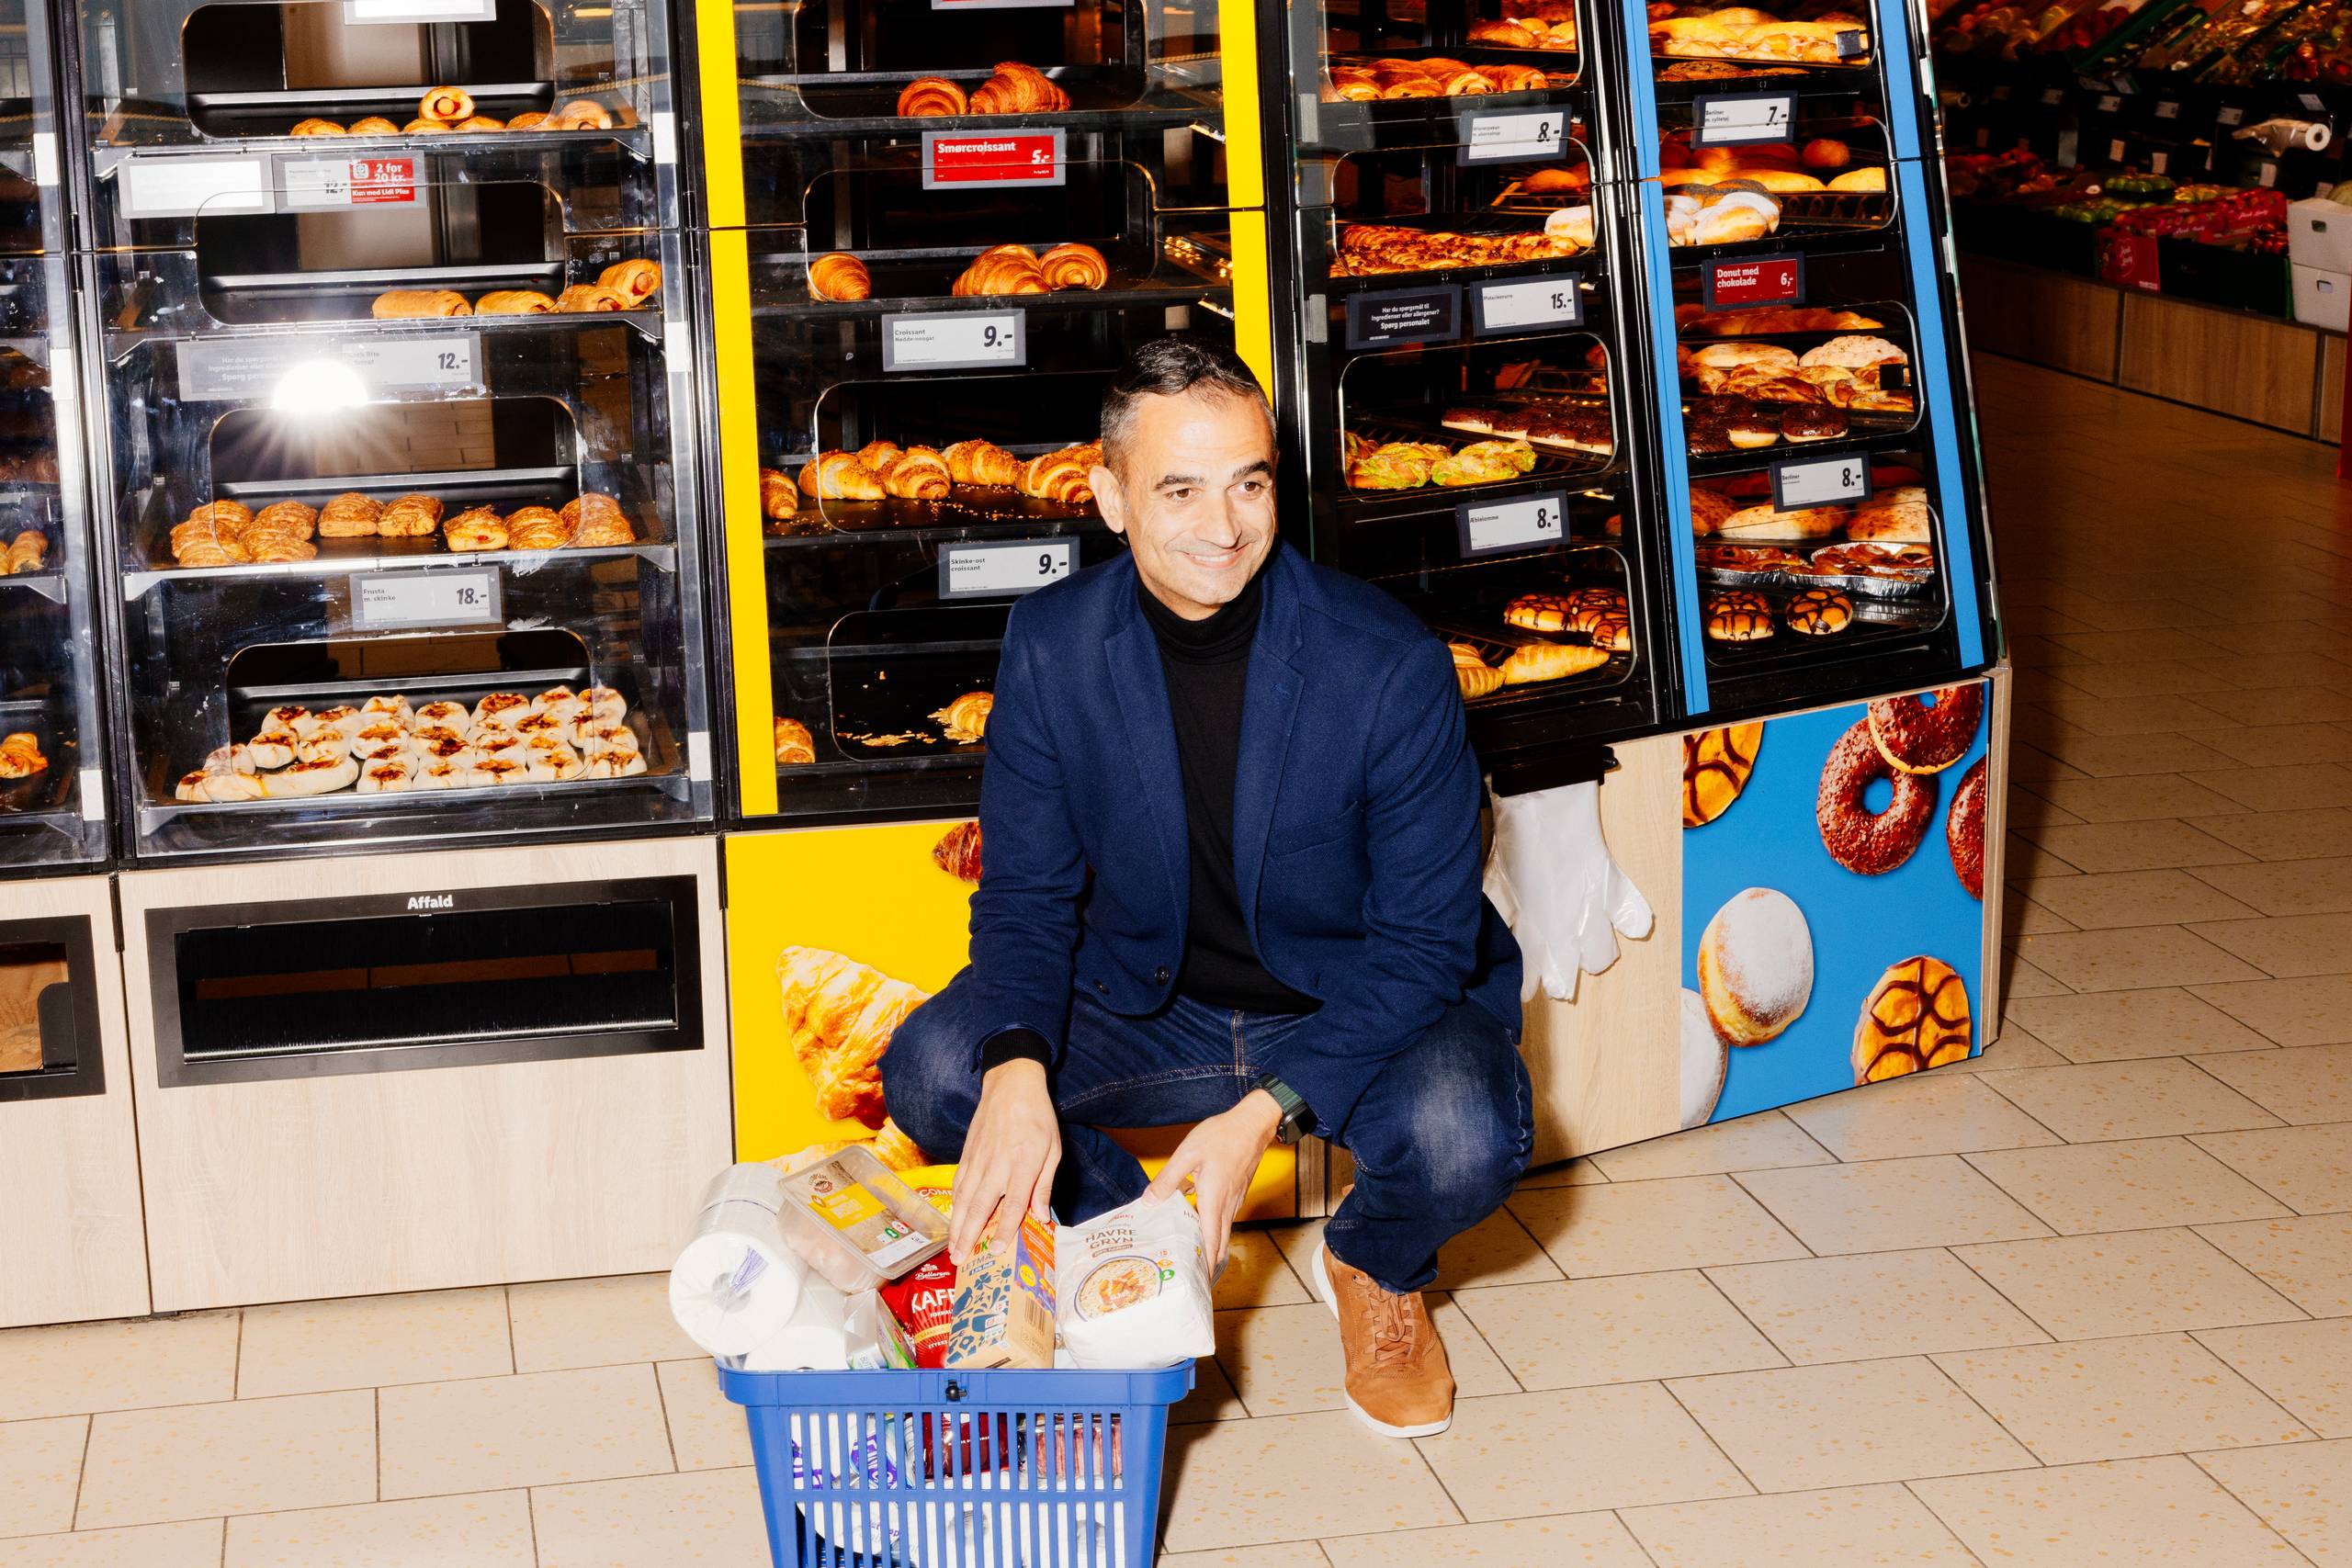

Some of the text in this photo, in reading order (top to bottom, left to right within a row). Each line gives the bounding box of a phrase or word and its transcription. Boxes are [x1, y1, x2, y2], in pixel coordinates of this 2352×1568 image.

[938, 141, 1016, 153] Smørcroissant
[1032, 149, 1050, 164] 5.-
[376, 163, 402, 174] 2 for
[374, 174, 389, 183] 20
[1716, 265, 1759, 278] Donut med
[1717, 276, 1757, 288] chokolade
[1551, 293, 1572, 310] 15.-
[1381, 319, 1430, 331] Spørg personalet
[984, 325, 1013, 348] 9.-
[438, 352, 469, 370] 12.-
[1842, 468, 1861, 488] 8.-
[1537, 507, 1559, 529] 8.-
[1038, 553, 1068, 575] 9.-
[457, 587, 488, 605] 18.-
[407, 895, 454, 909] Affald
[1086, 1228, 1138, 1244] HAVRE
[1090, 1236, 1133, 1250] GRYN
[911, 1288, 956, 1314] KAFF
